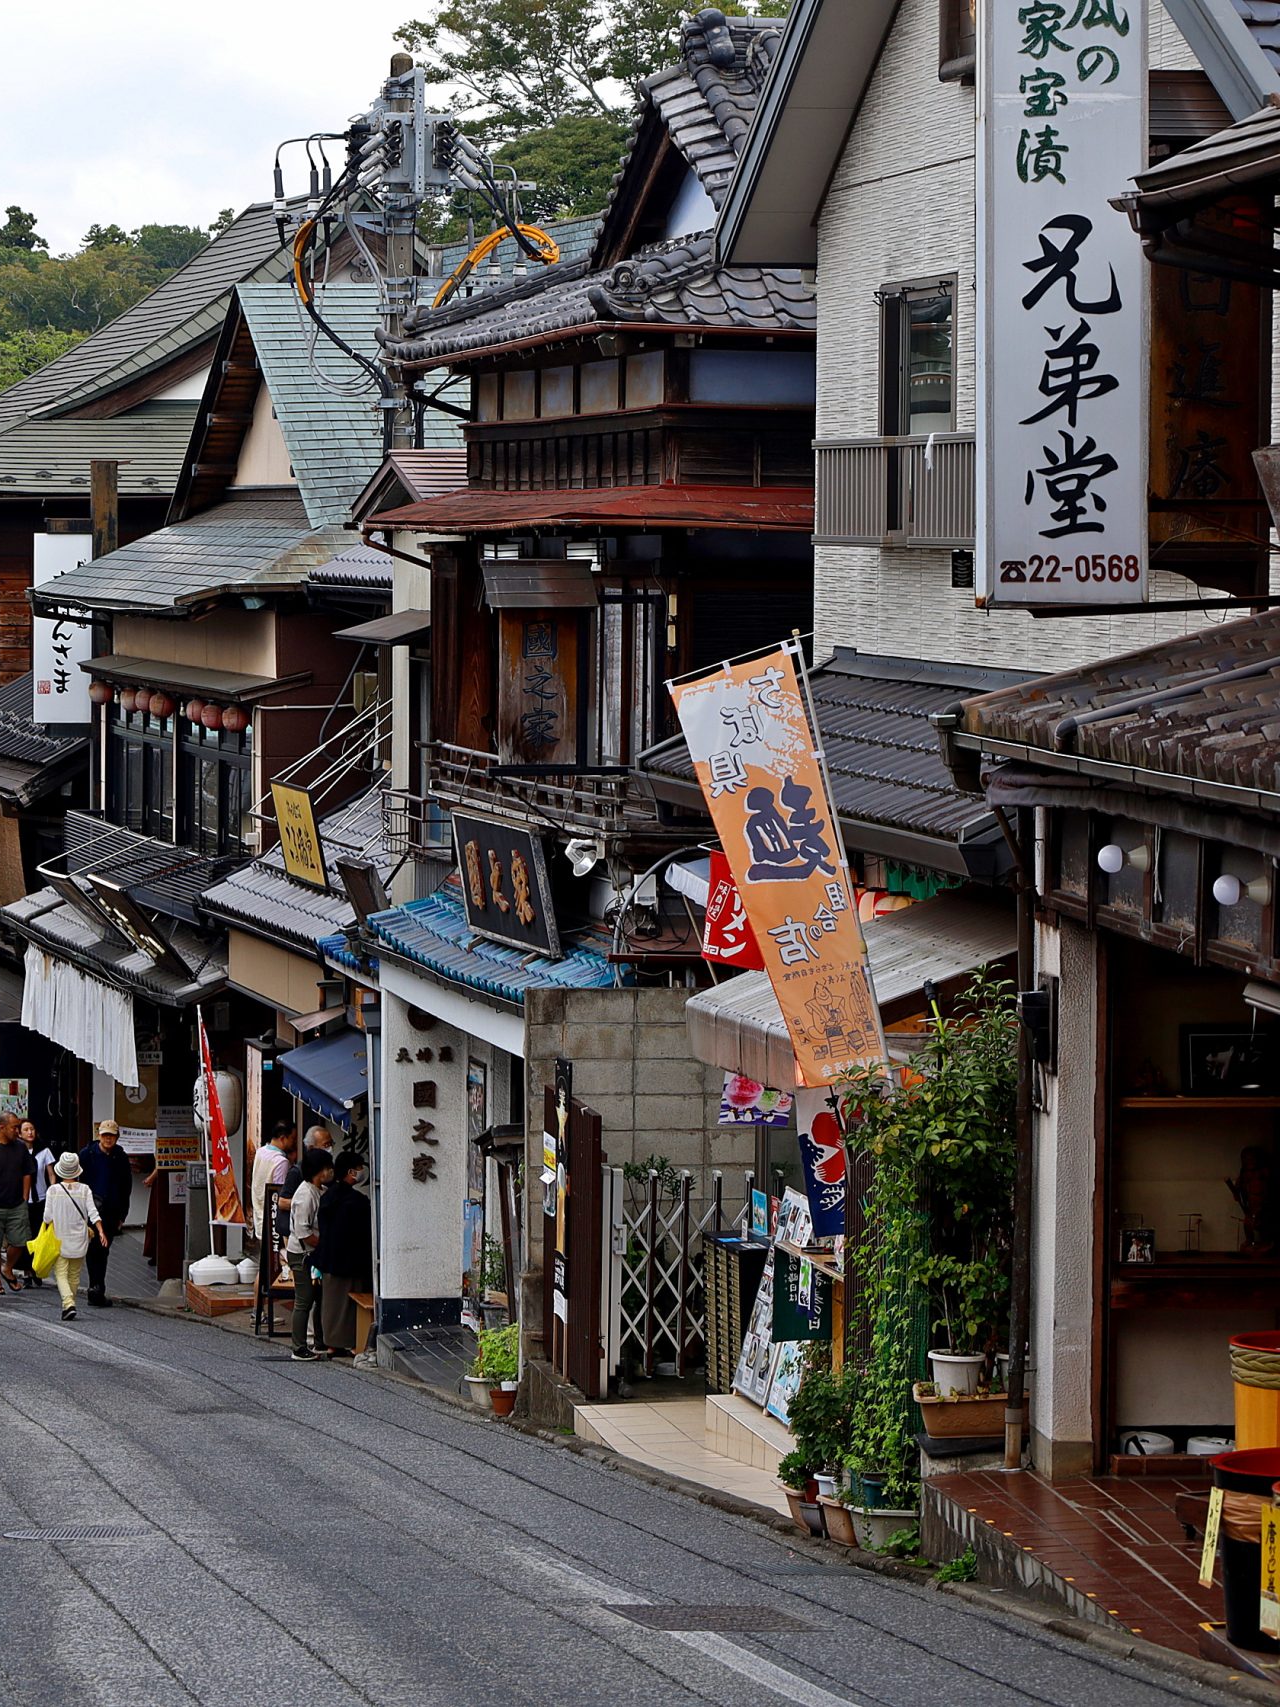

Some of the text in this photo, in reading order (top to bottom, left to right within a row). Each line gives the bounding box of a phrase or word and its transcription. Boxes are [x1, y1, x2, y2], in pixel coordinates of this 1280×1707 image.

[1016, 0, 1074, 186] 家宝漬
[1018, 213, 1122, 540] 兄弟堂
[1027, 554, 1140, 584] 22-0568
[411, 1080, 439, 1183] 國之家
